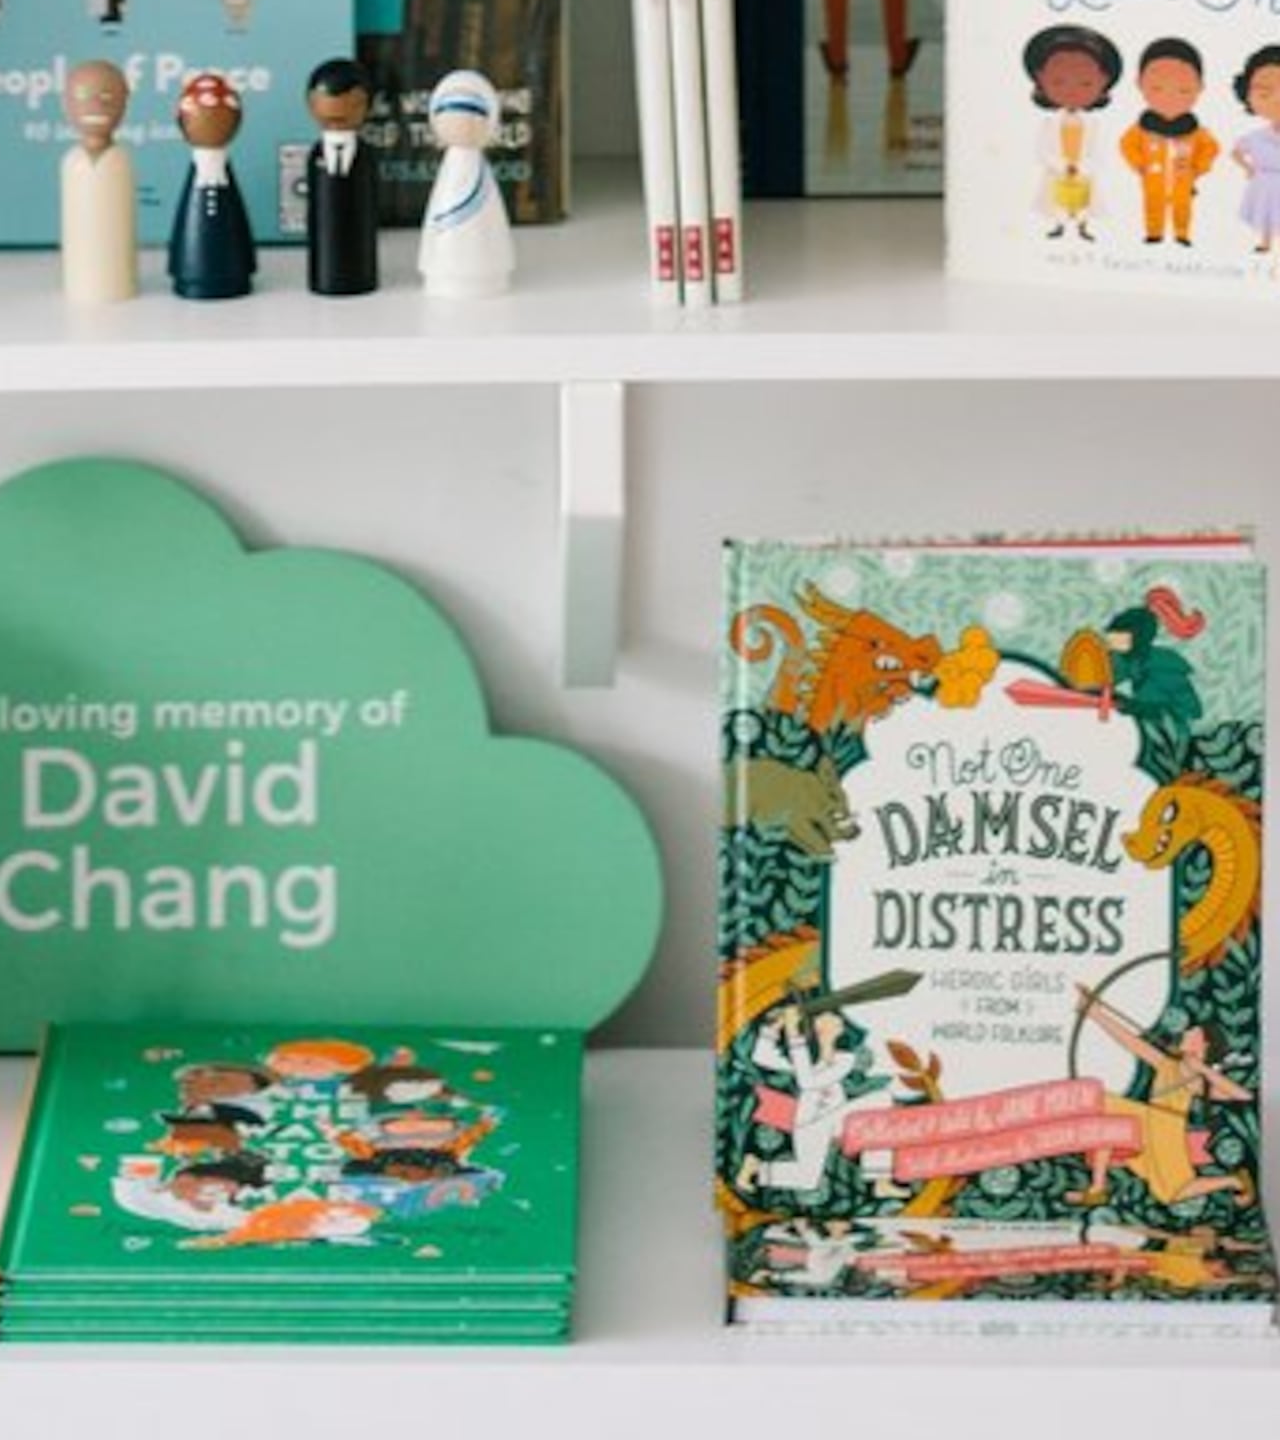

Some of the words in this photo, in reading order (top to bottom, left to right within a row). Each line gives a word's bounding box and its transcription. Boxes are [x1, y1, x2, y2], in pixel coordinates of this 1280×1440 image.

[153, 697, 349, 736] memory
[359, 690, 409, 729] of
[22, 739, 318, 829] David
[906, 736, 996, 786] Not
[999, 737, 1083, 791] One
[874, 790, 1124, 874] DAMSEL
[980, 860, 1019, 886] in
[873, 888, 1125, 957] DISTRESS
[928, 968, 1005, 994] HEROIC
[976, 996, 1020, 1016] FROM
